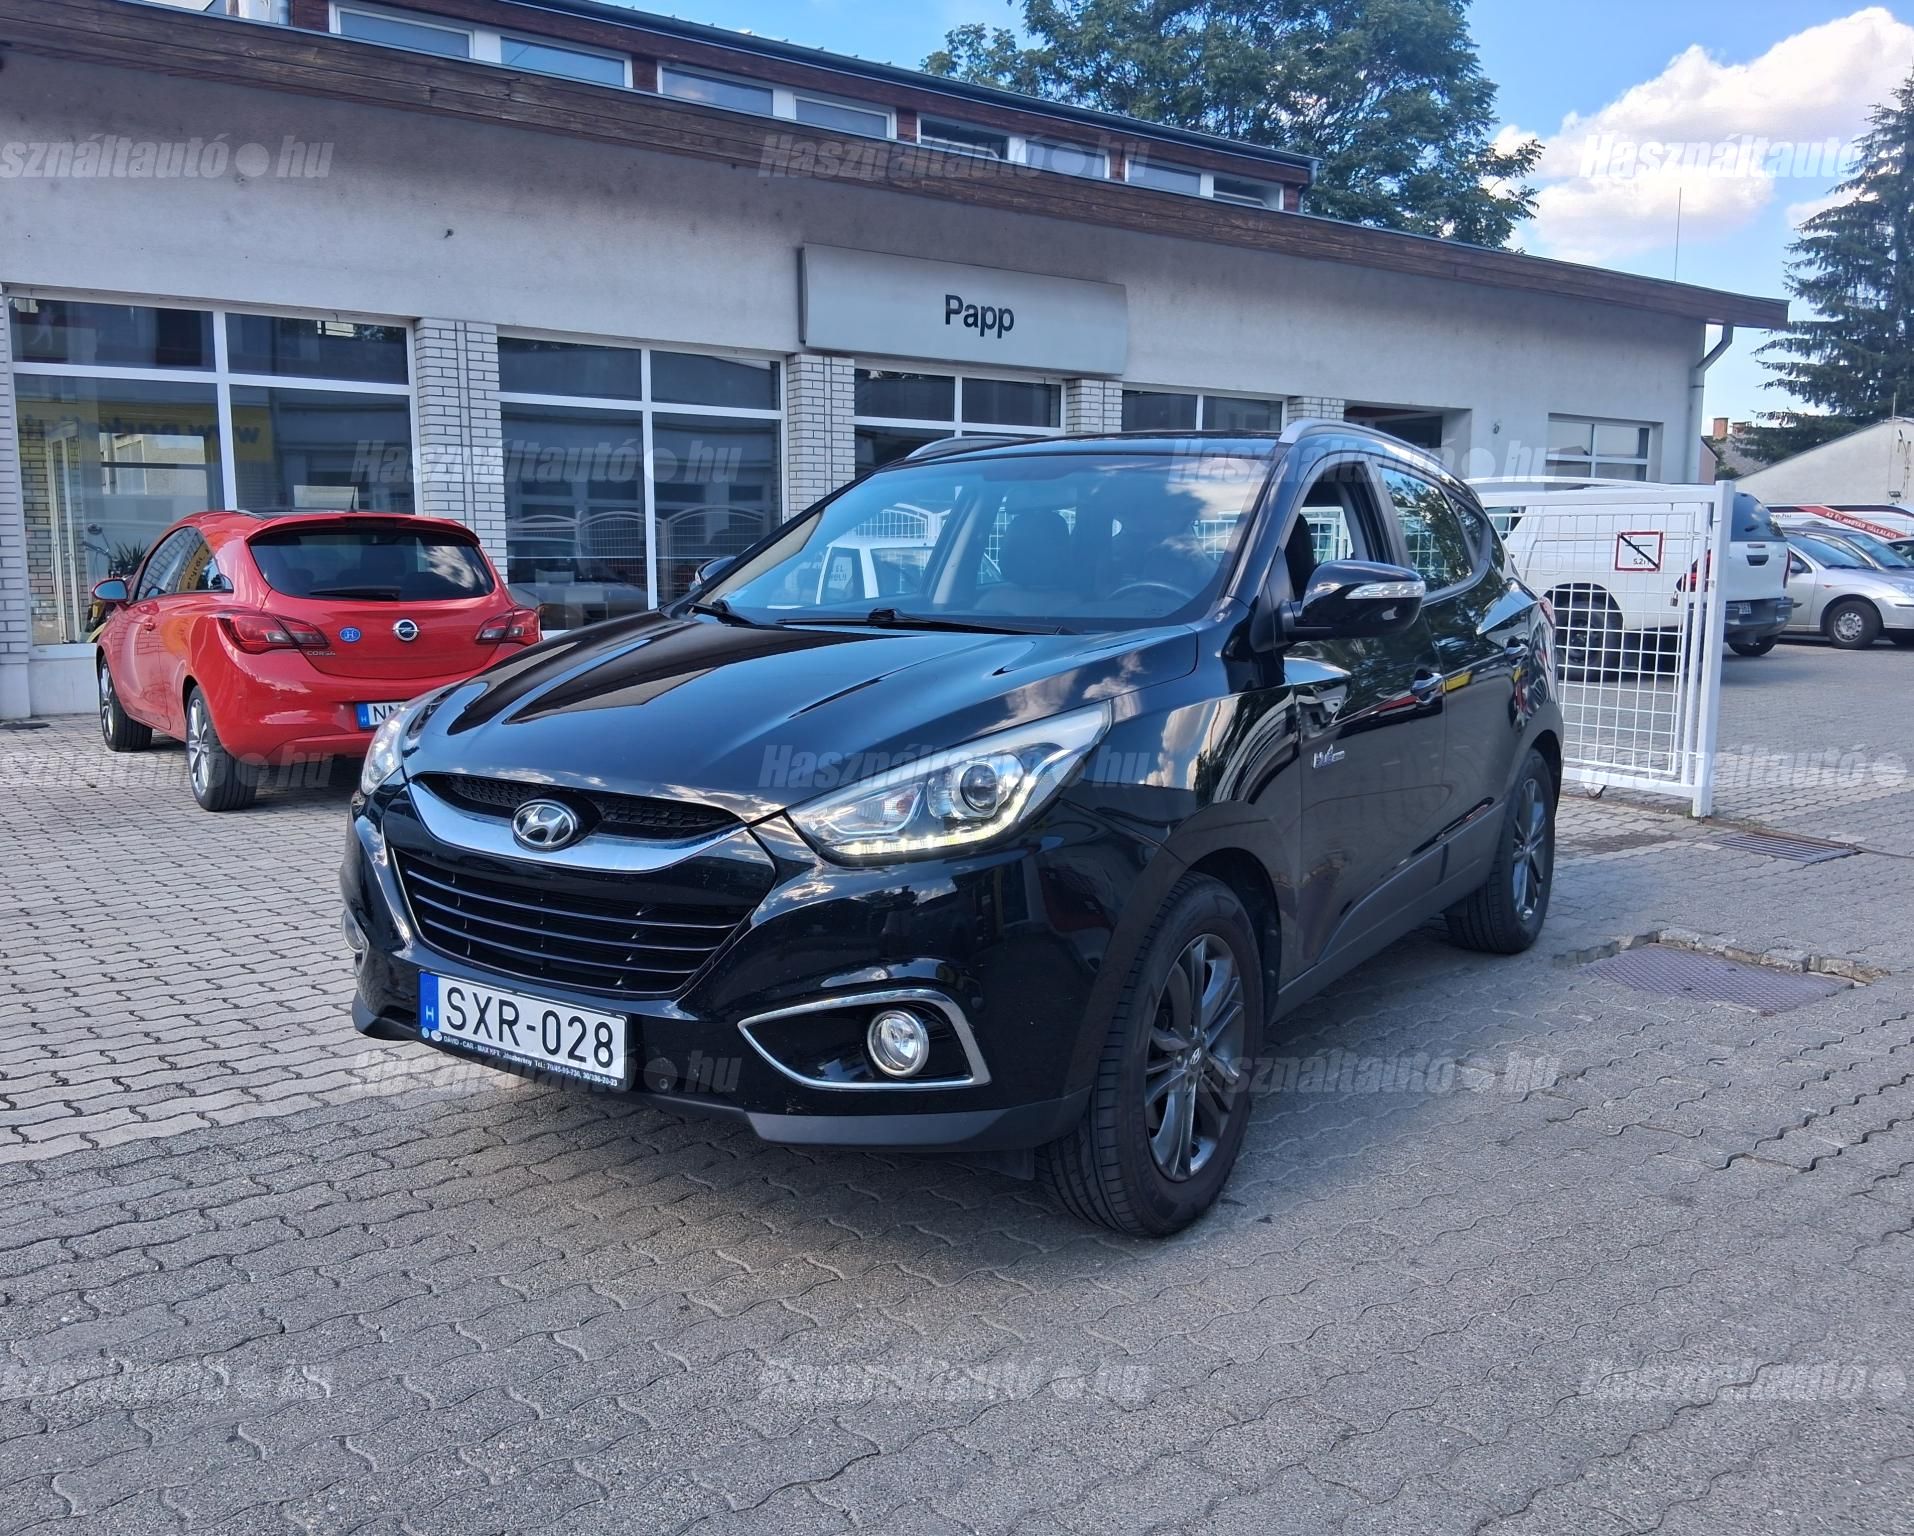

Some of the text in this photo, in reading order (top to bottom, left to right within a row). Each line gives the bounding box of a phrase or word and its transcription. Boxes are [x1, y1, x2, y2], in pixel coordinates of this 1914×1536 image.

[945, 294, 1014, 339] Papp
[425, 1005, 434, 1022] H
[446, 986, 614, 1069] SXR-028
